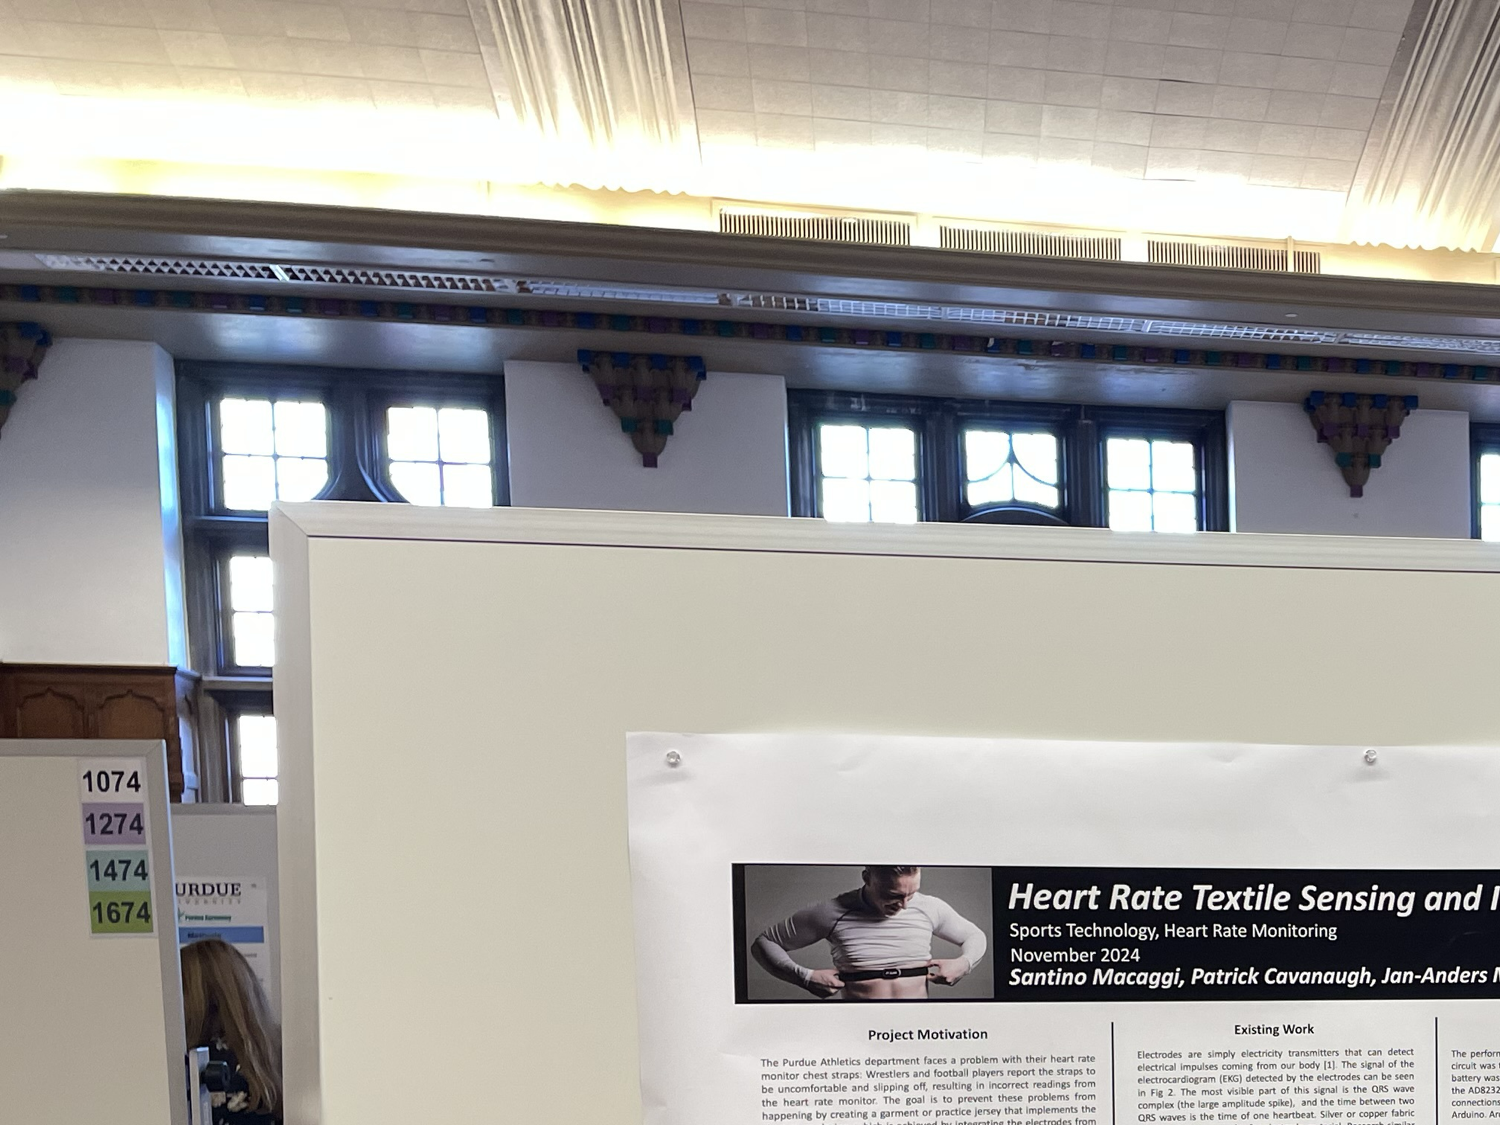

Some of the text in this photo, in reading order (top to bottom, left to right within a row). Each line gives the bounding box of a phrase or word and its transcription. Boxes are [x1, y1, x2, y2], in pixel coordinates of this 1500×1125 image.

[82, 770, 141, 793] 1074
[85, 813, 144, 835] 1274
[89, 859, 148, 882] 1474
[175, 882, 241, 897] URDUE
[1007, 882, 1102, 910] Heart
[1108, 883, 1183, 911] Rate
[1191, 882, 1291, 911] Textile
[1297, 883, 1416, 918] Sensing
[1423, 883, 1484, 912] and
[92, 901, 151, 924] 1674
[1009, 921, 1337, 941] Sports Technology, Heart Rate Monitoring
[1010, 947, 1140, 962] November 2024
[1008, 967, 1087, 985] Santino
[1091, 966, 1185, 989] Macaggi,
[1190, 965, 1260, 985] Patrick
[1263, 965, 1377, 988] Cavanaugh,
[1380, 965, 1488, 984] Jan-Anders
[868, 1028, 988, 1043] Project Motivation
[1234, 1023, 1314, 1037] Existing Work
